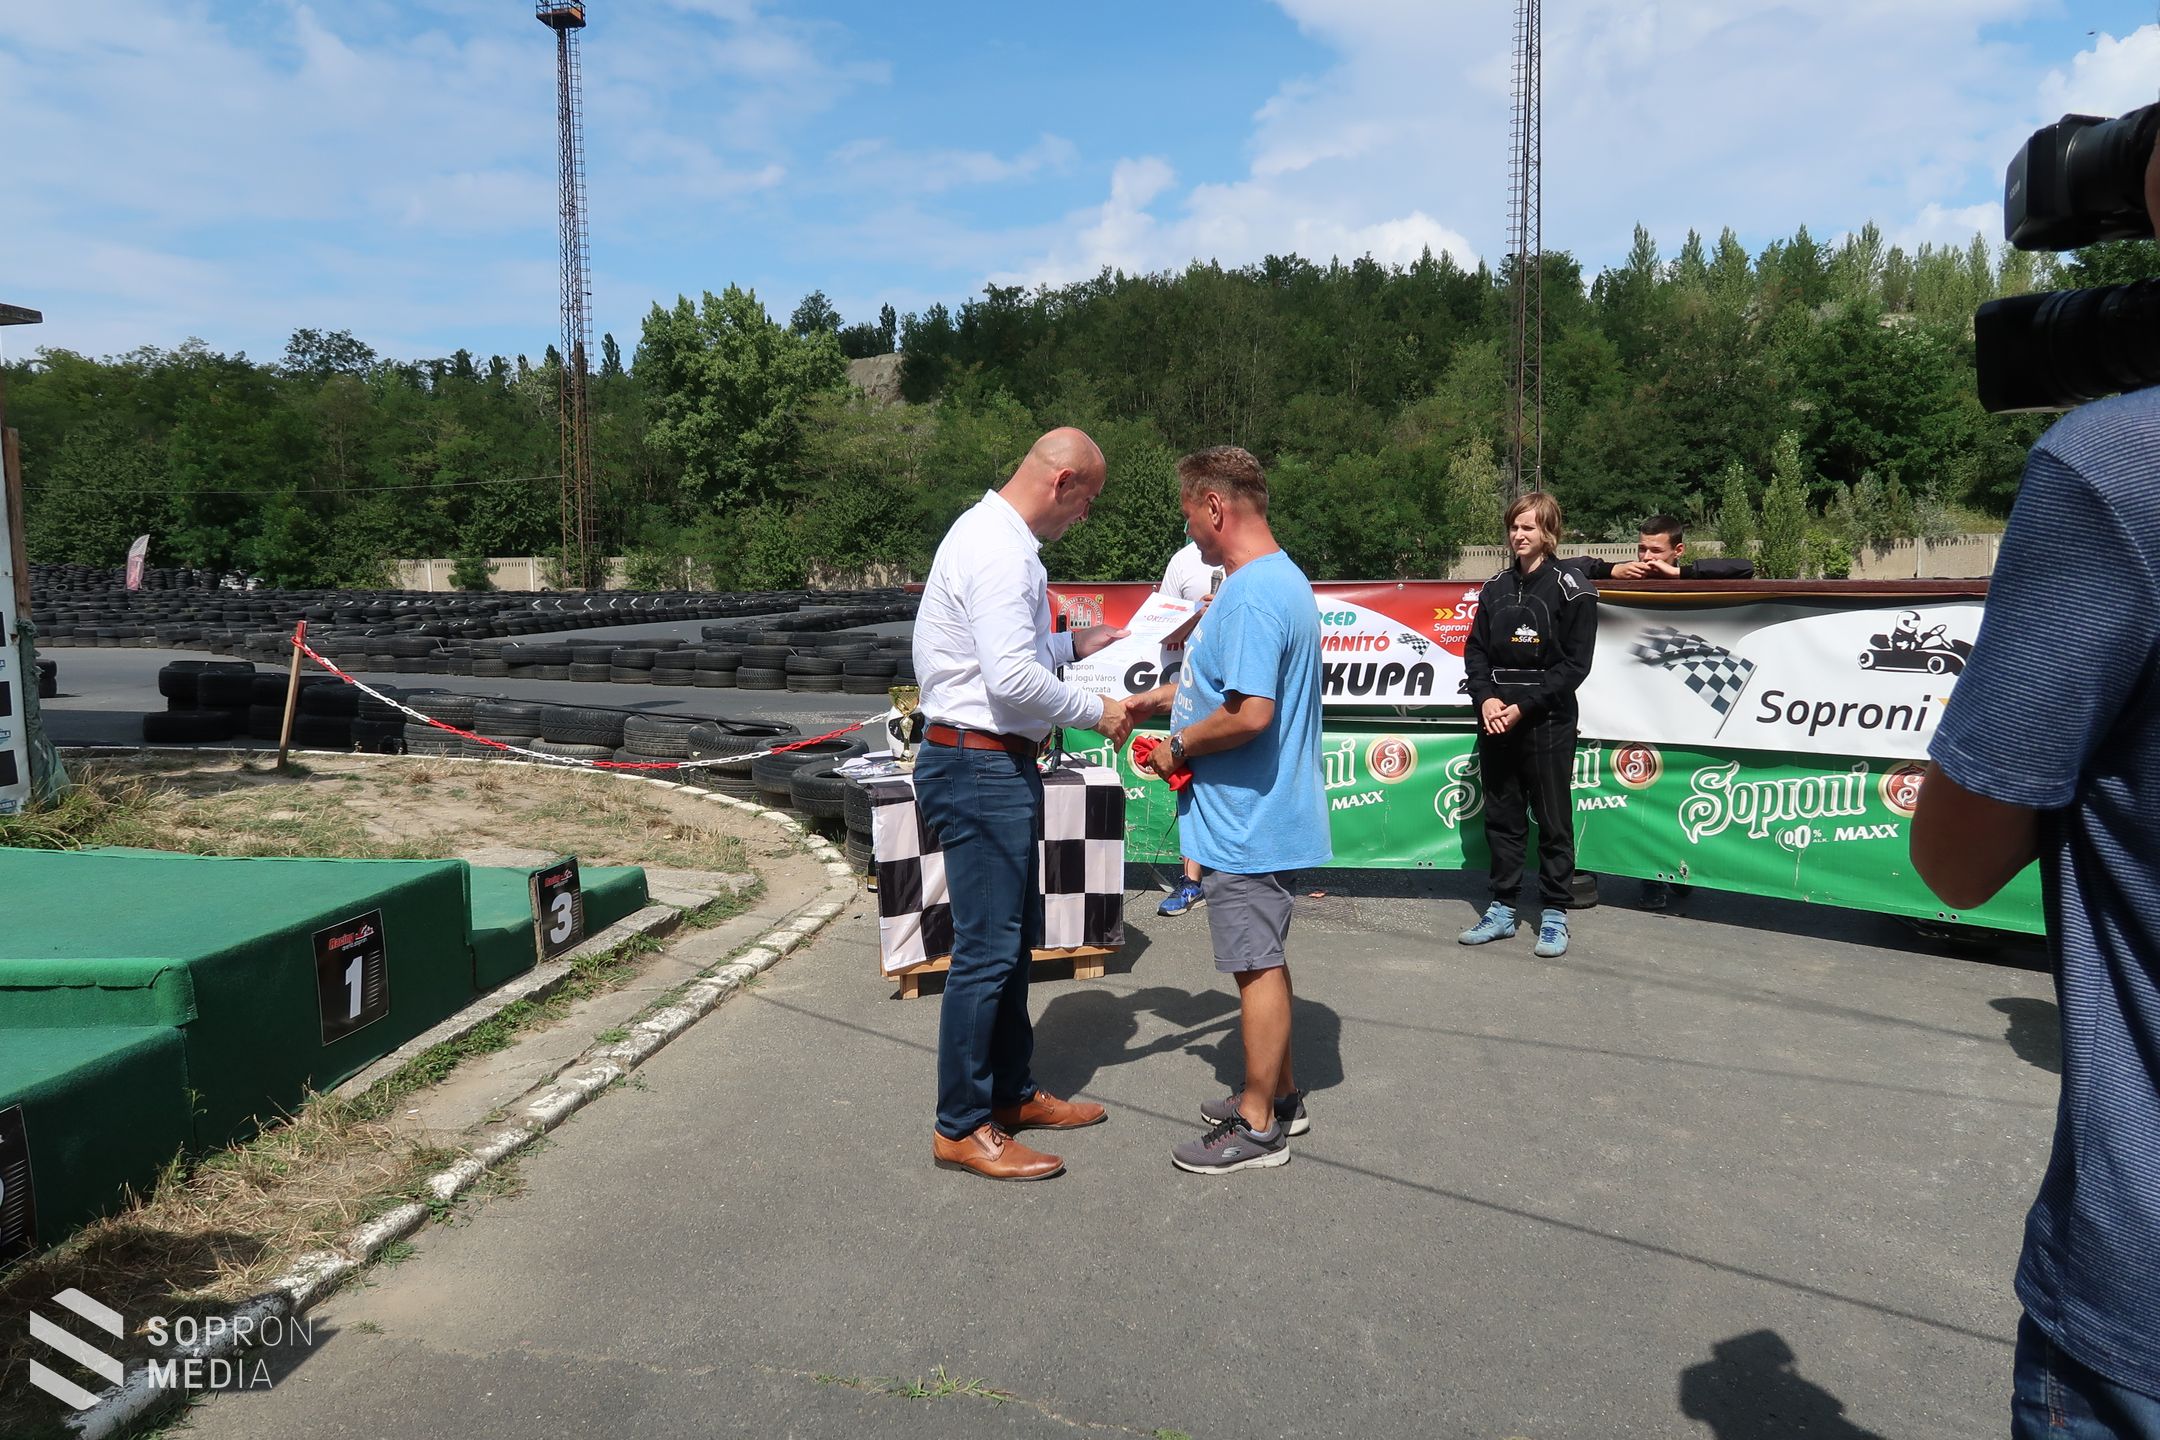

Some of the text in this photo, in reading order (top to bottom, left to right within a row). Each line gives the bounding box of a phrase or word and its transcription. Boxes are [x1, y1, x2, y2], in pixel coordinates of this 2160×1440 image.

[1433, 622, 1470, 634] Soproni
[1095, 673, 1117, 683] Város
[1322, 661, 1435, 696] KUPA
[1756, 690, 1932, 737] Soproni
[1331, 790, 1385, 811] MAXX
[1576, 795, 1629, 812] MAXX
[1678, 760, 1869, 844] Soproni
[1834, 823, 1900, 842] MAXX
[550, 892, 573, 944] 3
[345, 955, 363, 1019] 1
